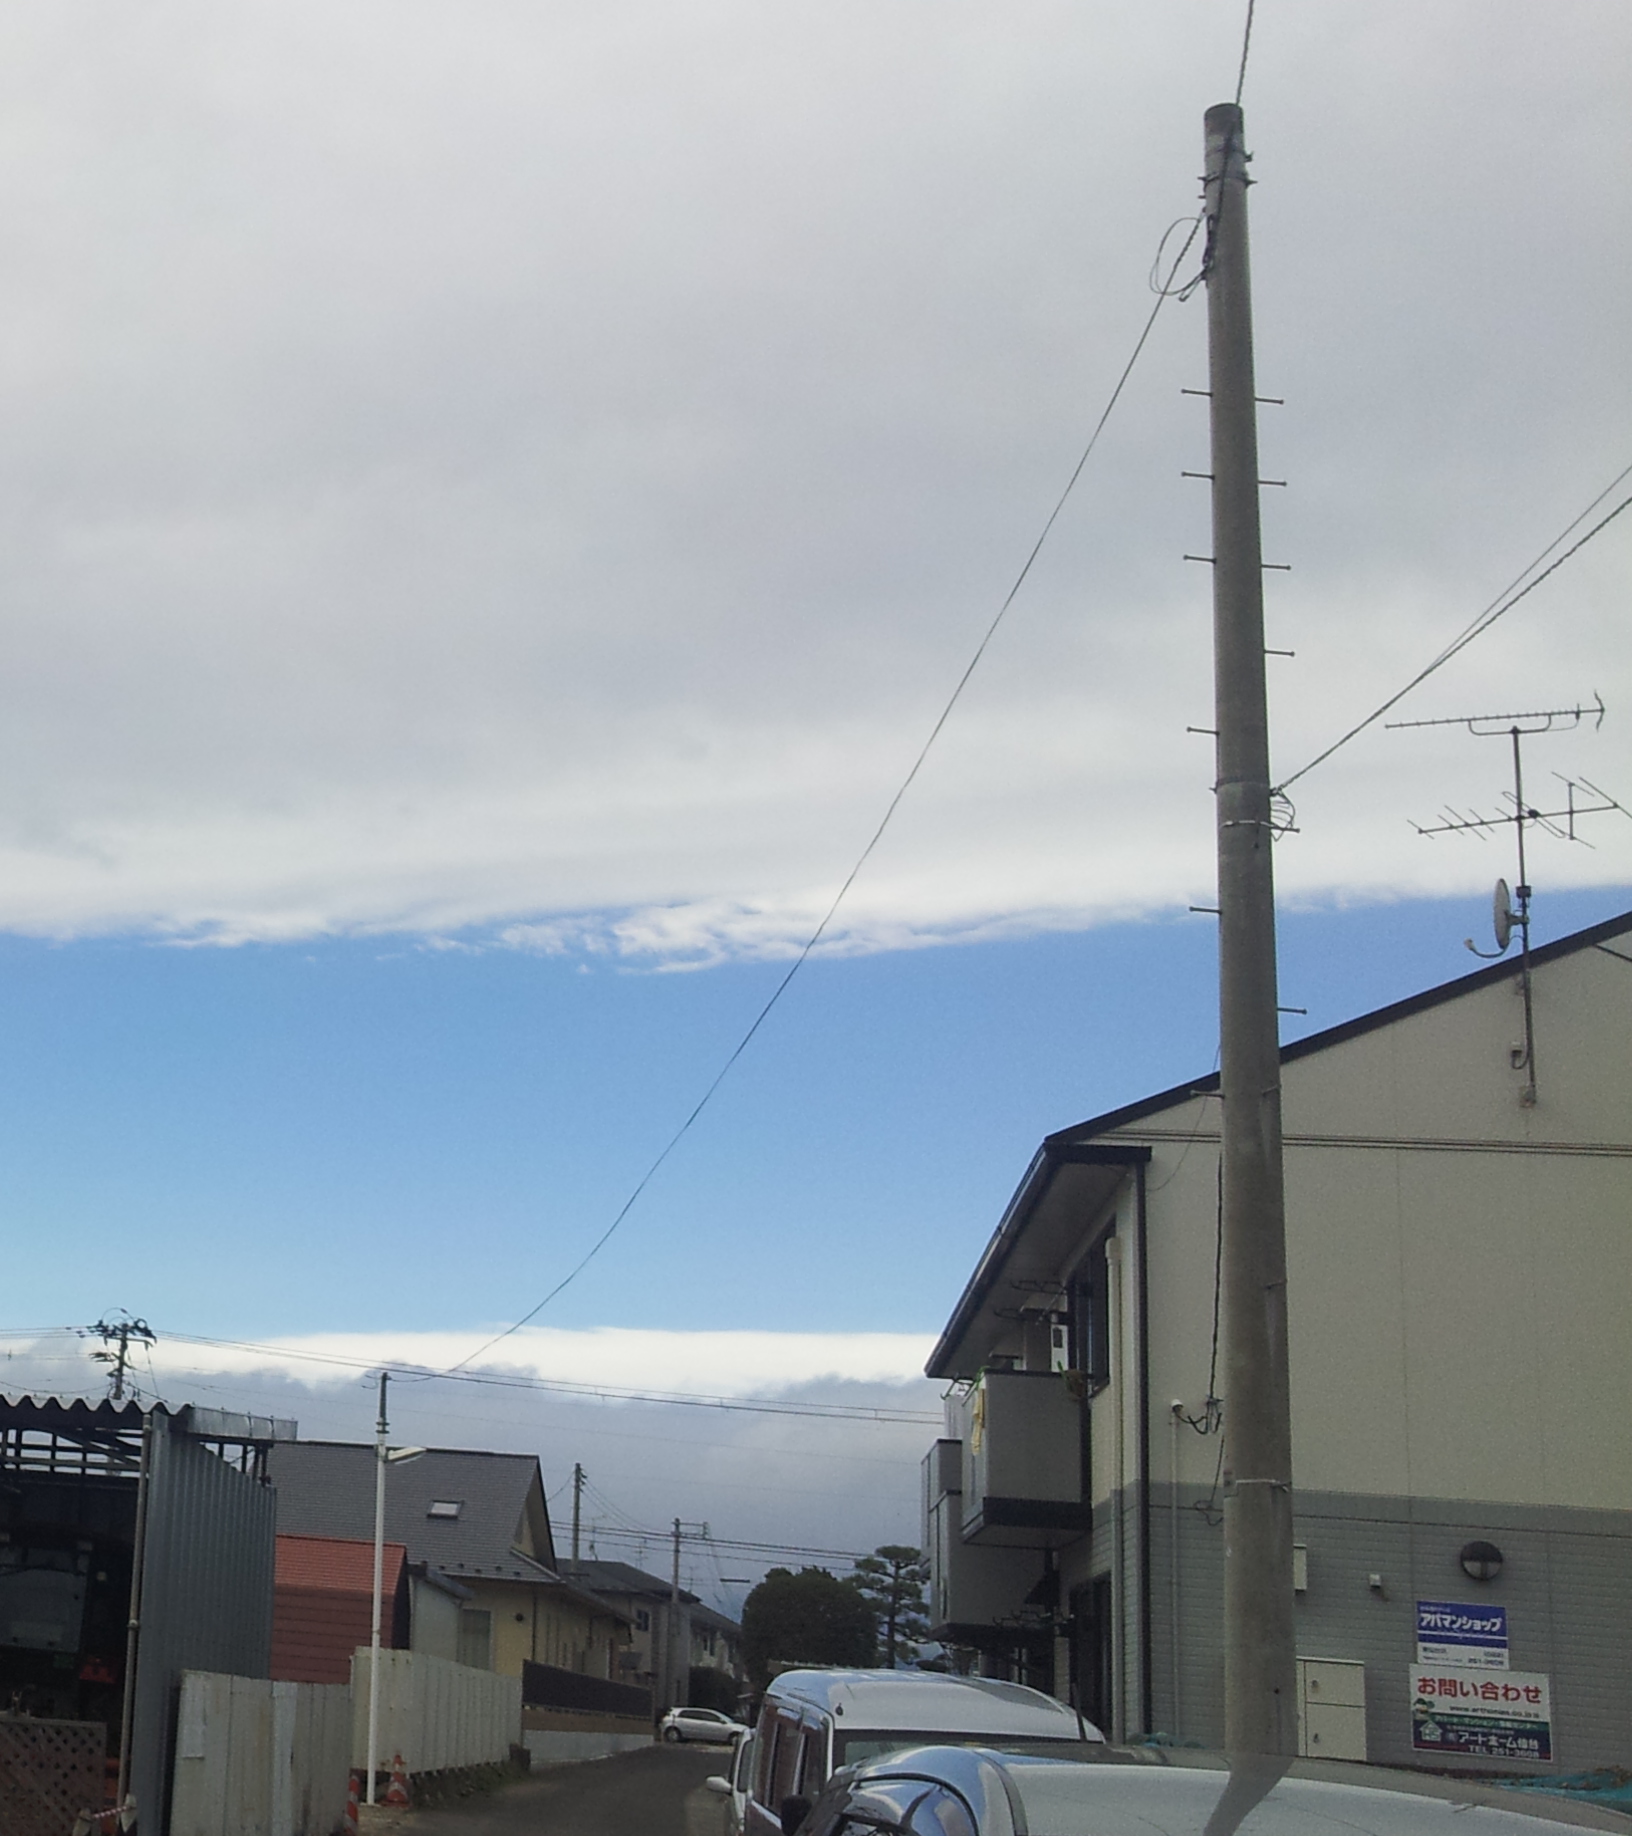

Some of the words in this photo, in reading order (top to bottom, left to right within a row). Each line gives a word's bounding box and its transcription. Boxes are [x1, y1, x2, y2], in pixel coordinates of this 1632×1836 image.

[1420, 1613, 1502, 1632] アパマンショップ
[1417, 1676, 1542, 1705] お問い合わせ
[1458, 1731, 1539, 1750] アートホーム仙台
[1468, 1744, 1487, 1754] TEL
